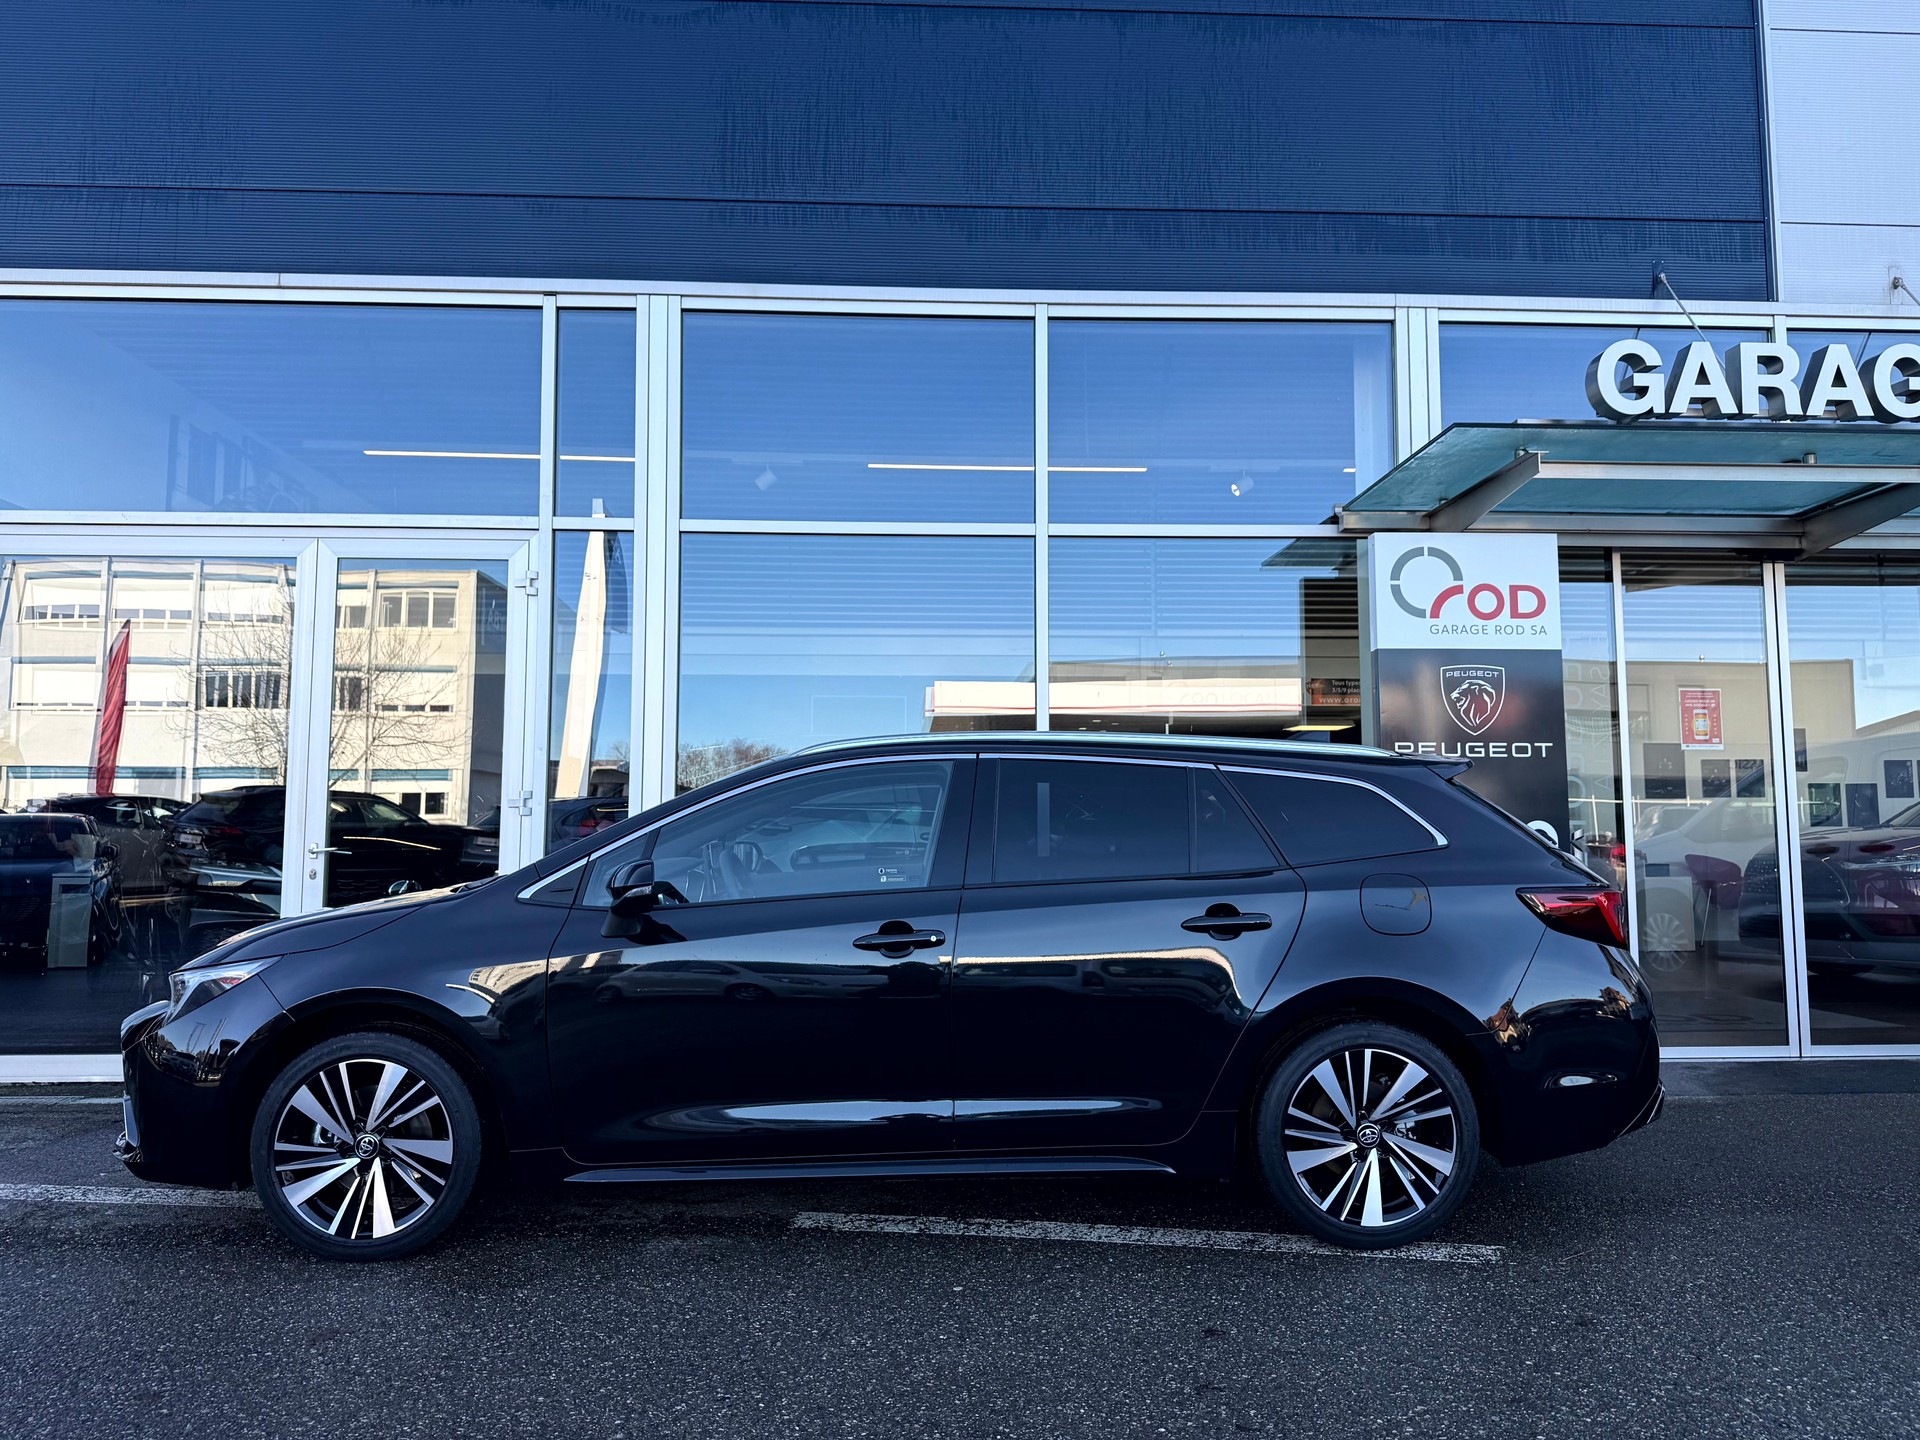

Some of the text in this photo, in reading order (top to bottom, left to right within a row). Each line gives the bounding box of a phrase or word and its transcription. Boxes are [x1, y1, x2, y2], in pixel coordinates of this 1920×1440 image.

[1587, 338, 1920, 420] GARAG
[1429, 624, 1548, 636] GARAGE ROD SA
[1446, 670, 1500, 678] PEUGEOT
[1394, 741, 1554, 758] PEUGEOT
